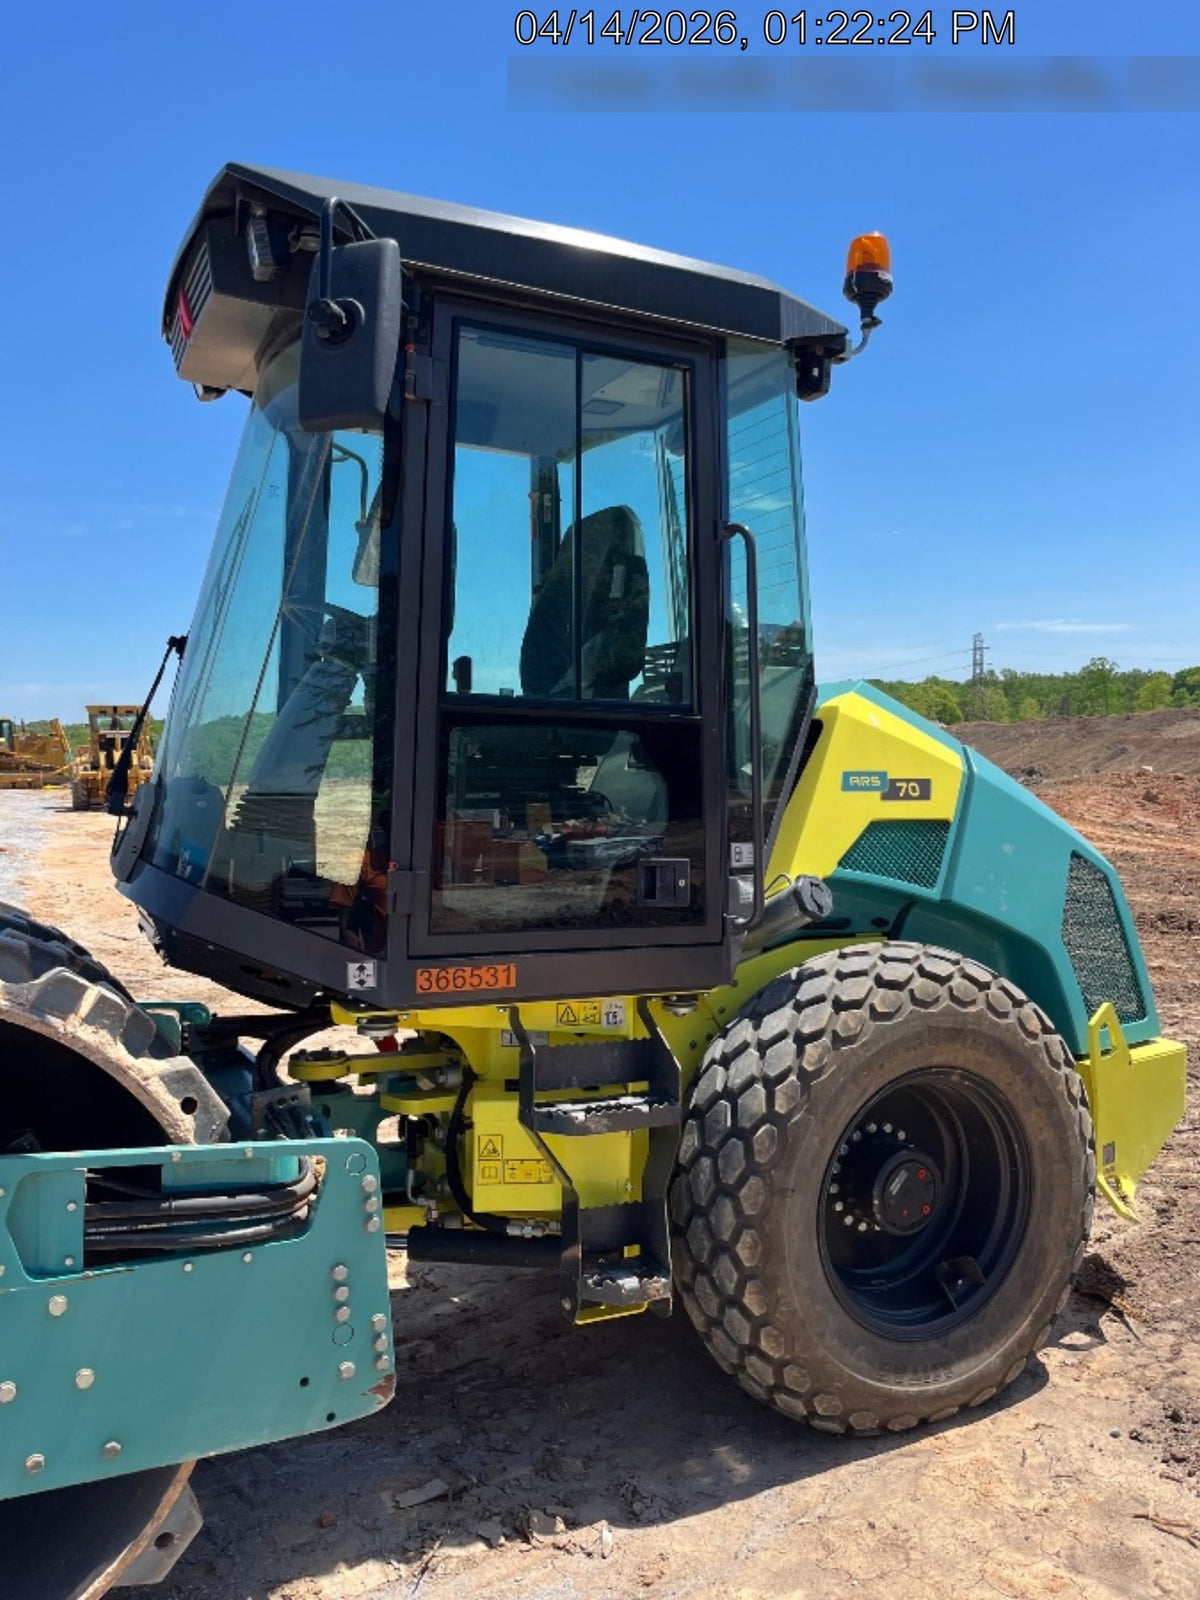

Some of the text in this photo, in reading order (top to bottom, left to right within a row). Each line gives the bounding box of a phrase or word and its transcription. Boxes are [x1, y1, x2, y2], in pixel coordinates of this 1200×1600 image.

[849, 776, 920, 798] ARS 70
[418, 964, 512, 991] 366531
